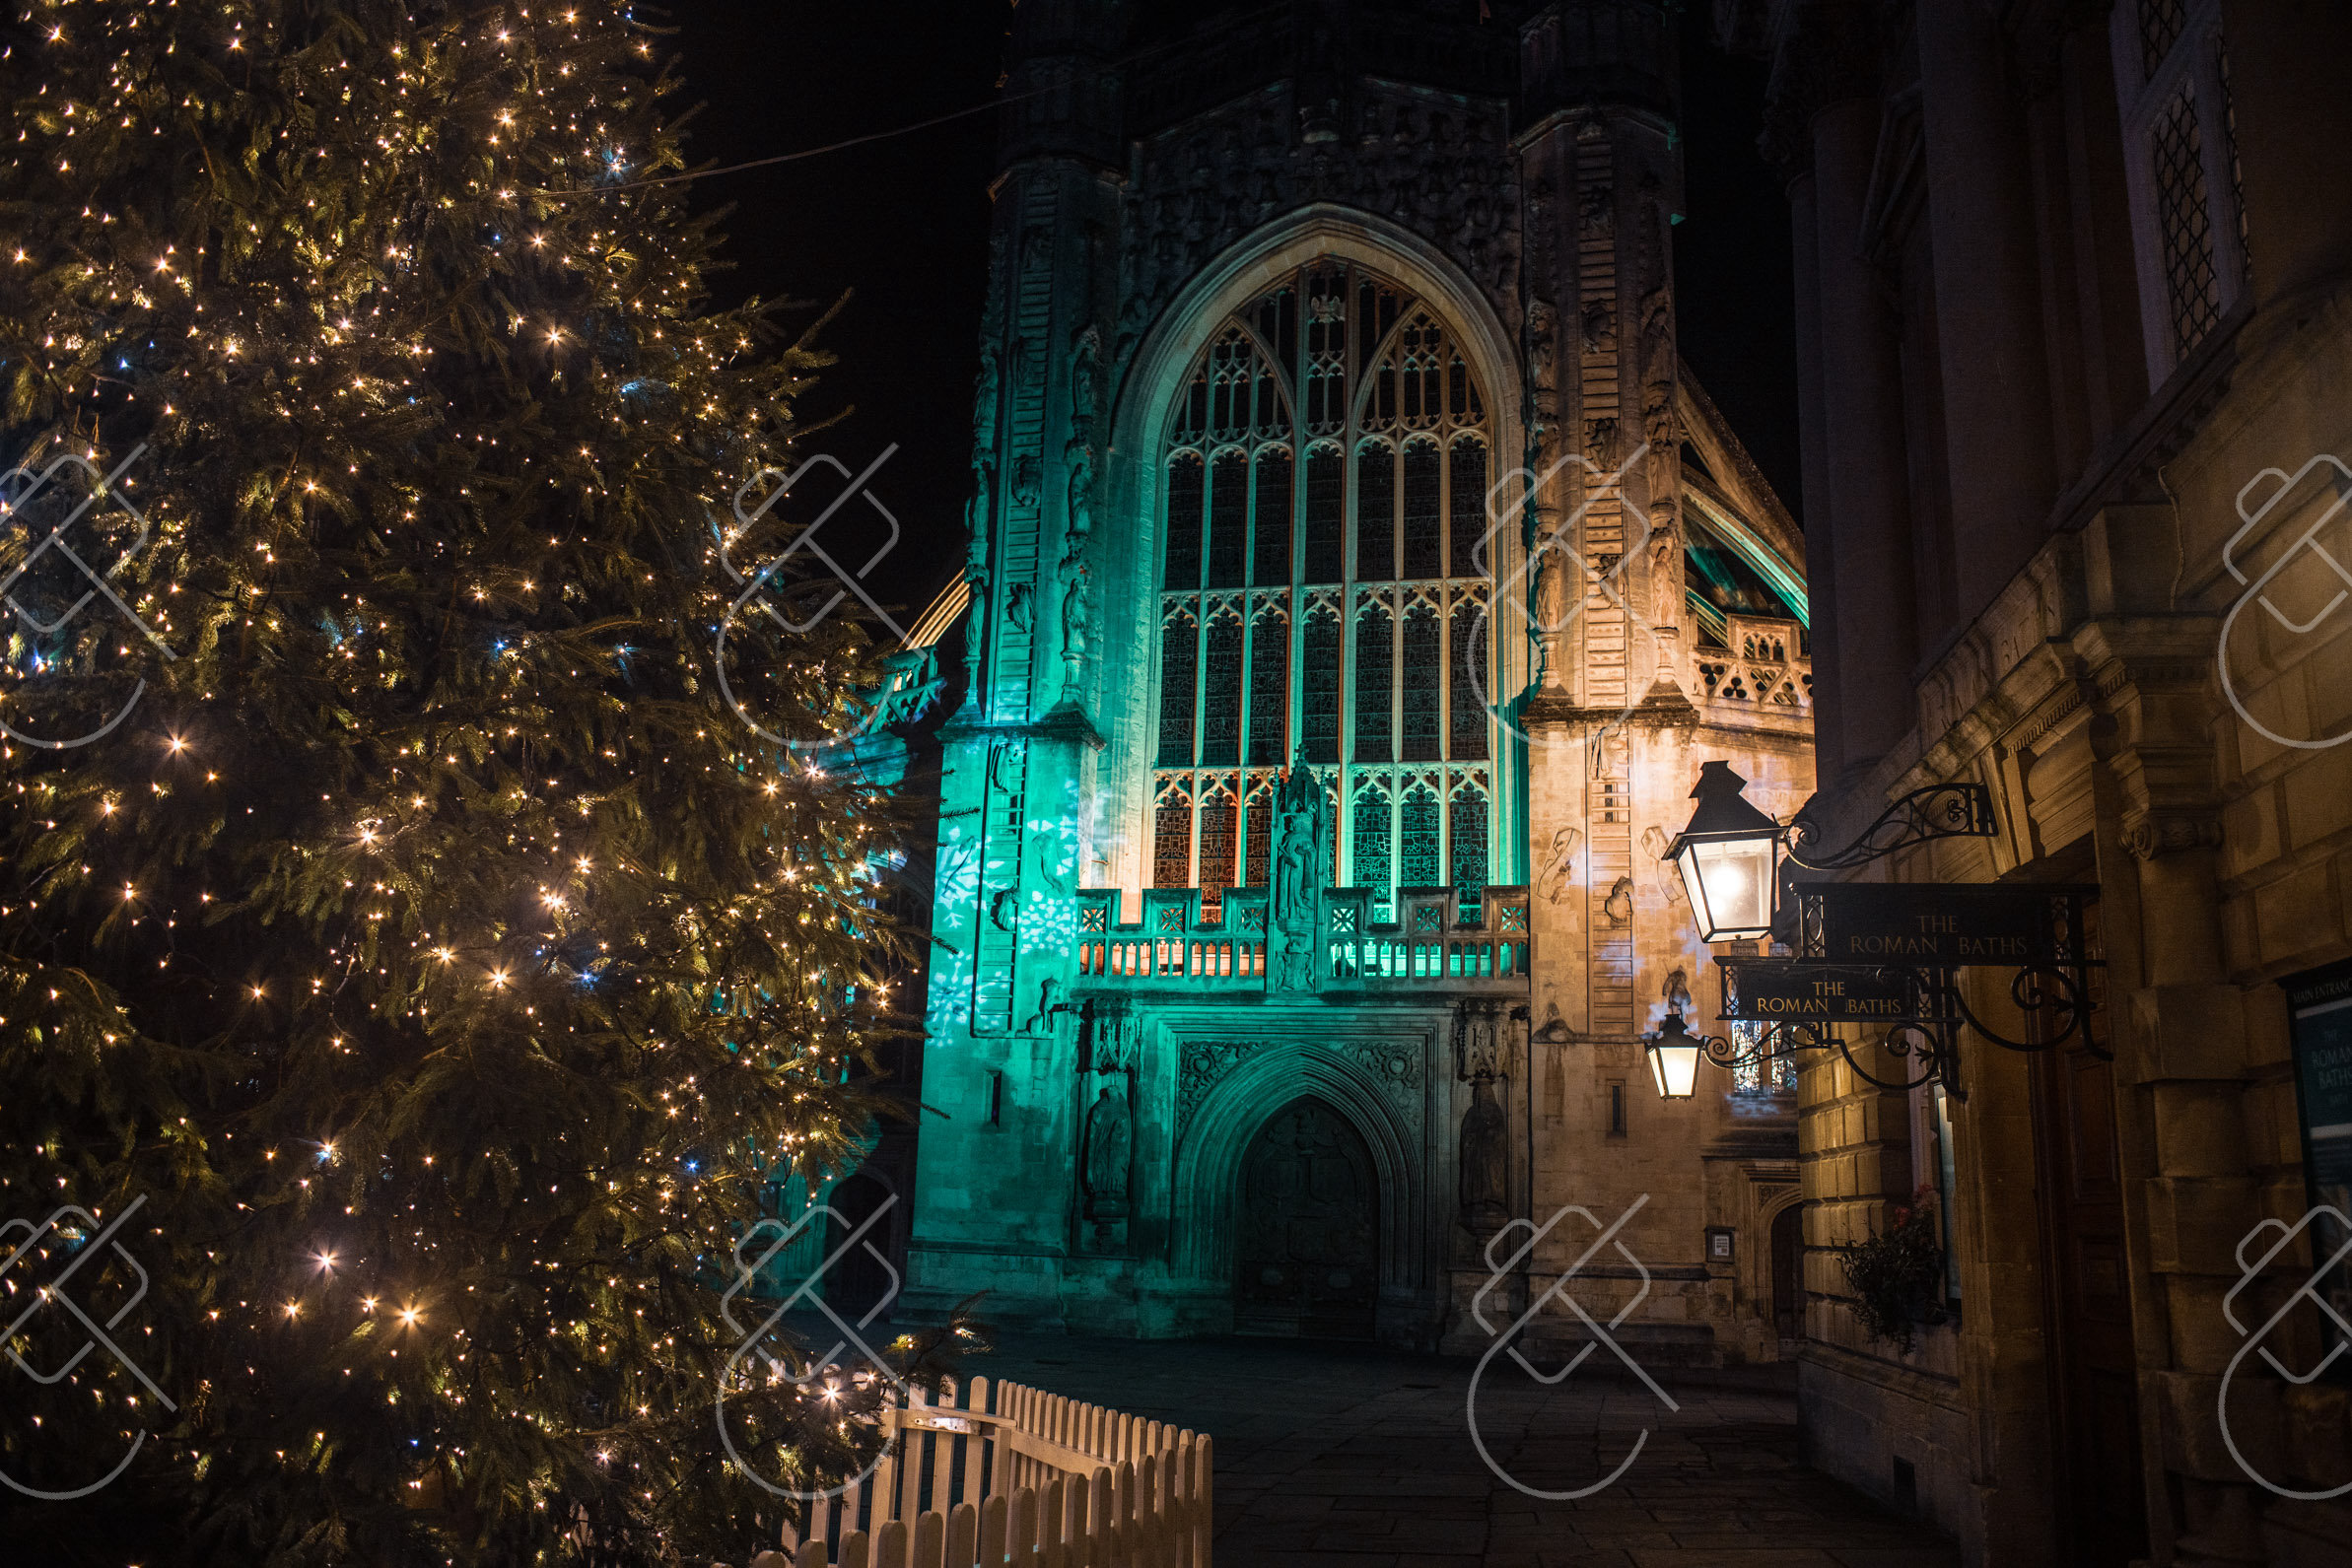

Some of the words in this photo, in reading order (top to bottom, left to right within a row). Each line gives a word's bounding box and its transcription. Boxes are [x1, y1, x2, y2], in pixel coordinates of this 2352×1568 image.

[1915, 915, 1959, 933] THE
[1850, 935, 1939, 955] ROMAN
[1958, 936, 2029, 955] BATHS
[1812, 981, 1845, 996] THE
[1757, 997, 1830, 1014] ROMAN
[1846, 998, 1902, 1014] BATHS
